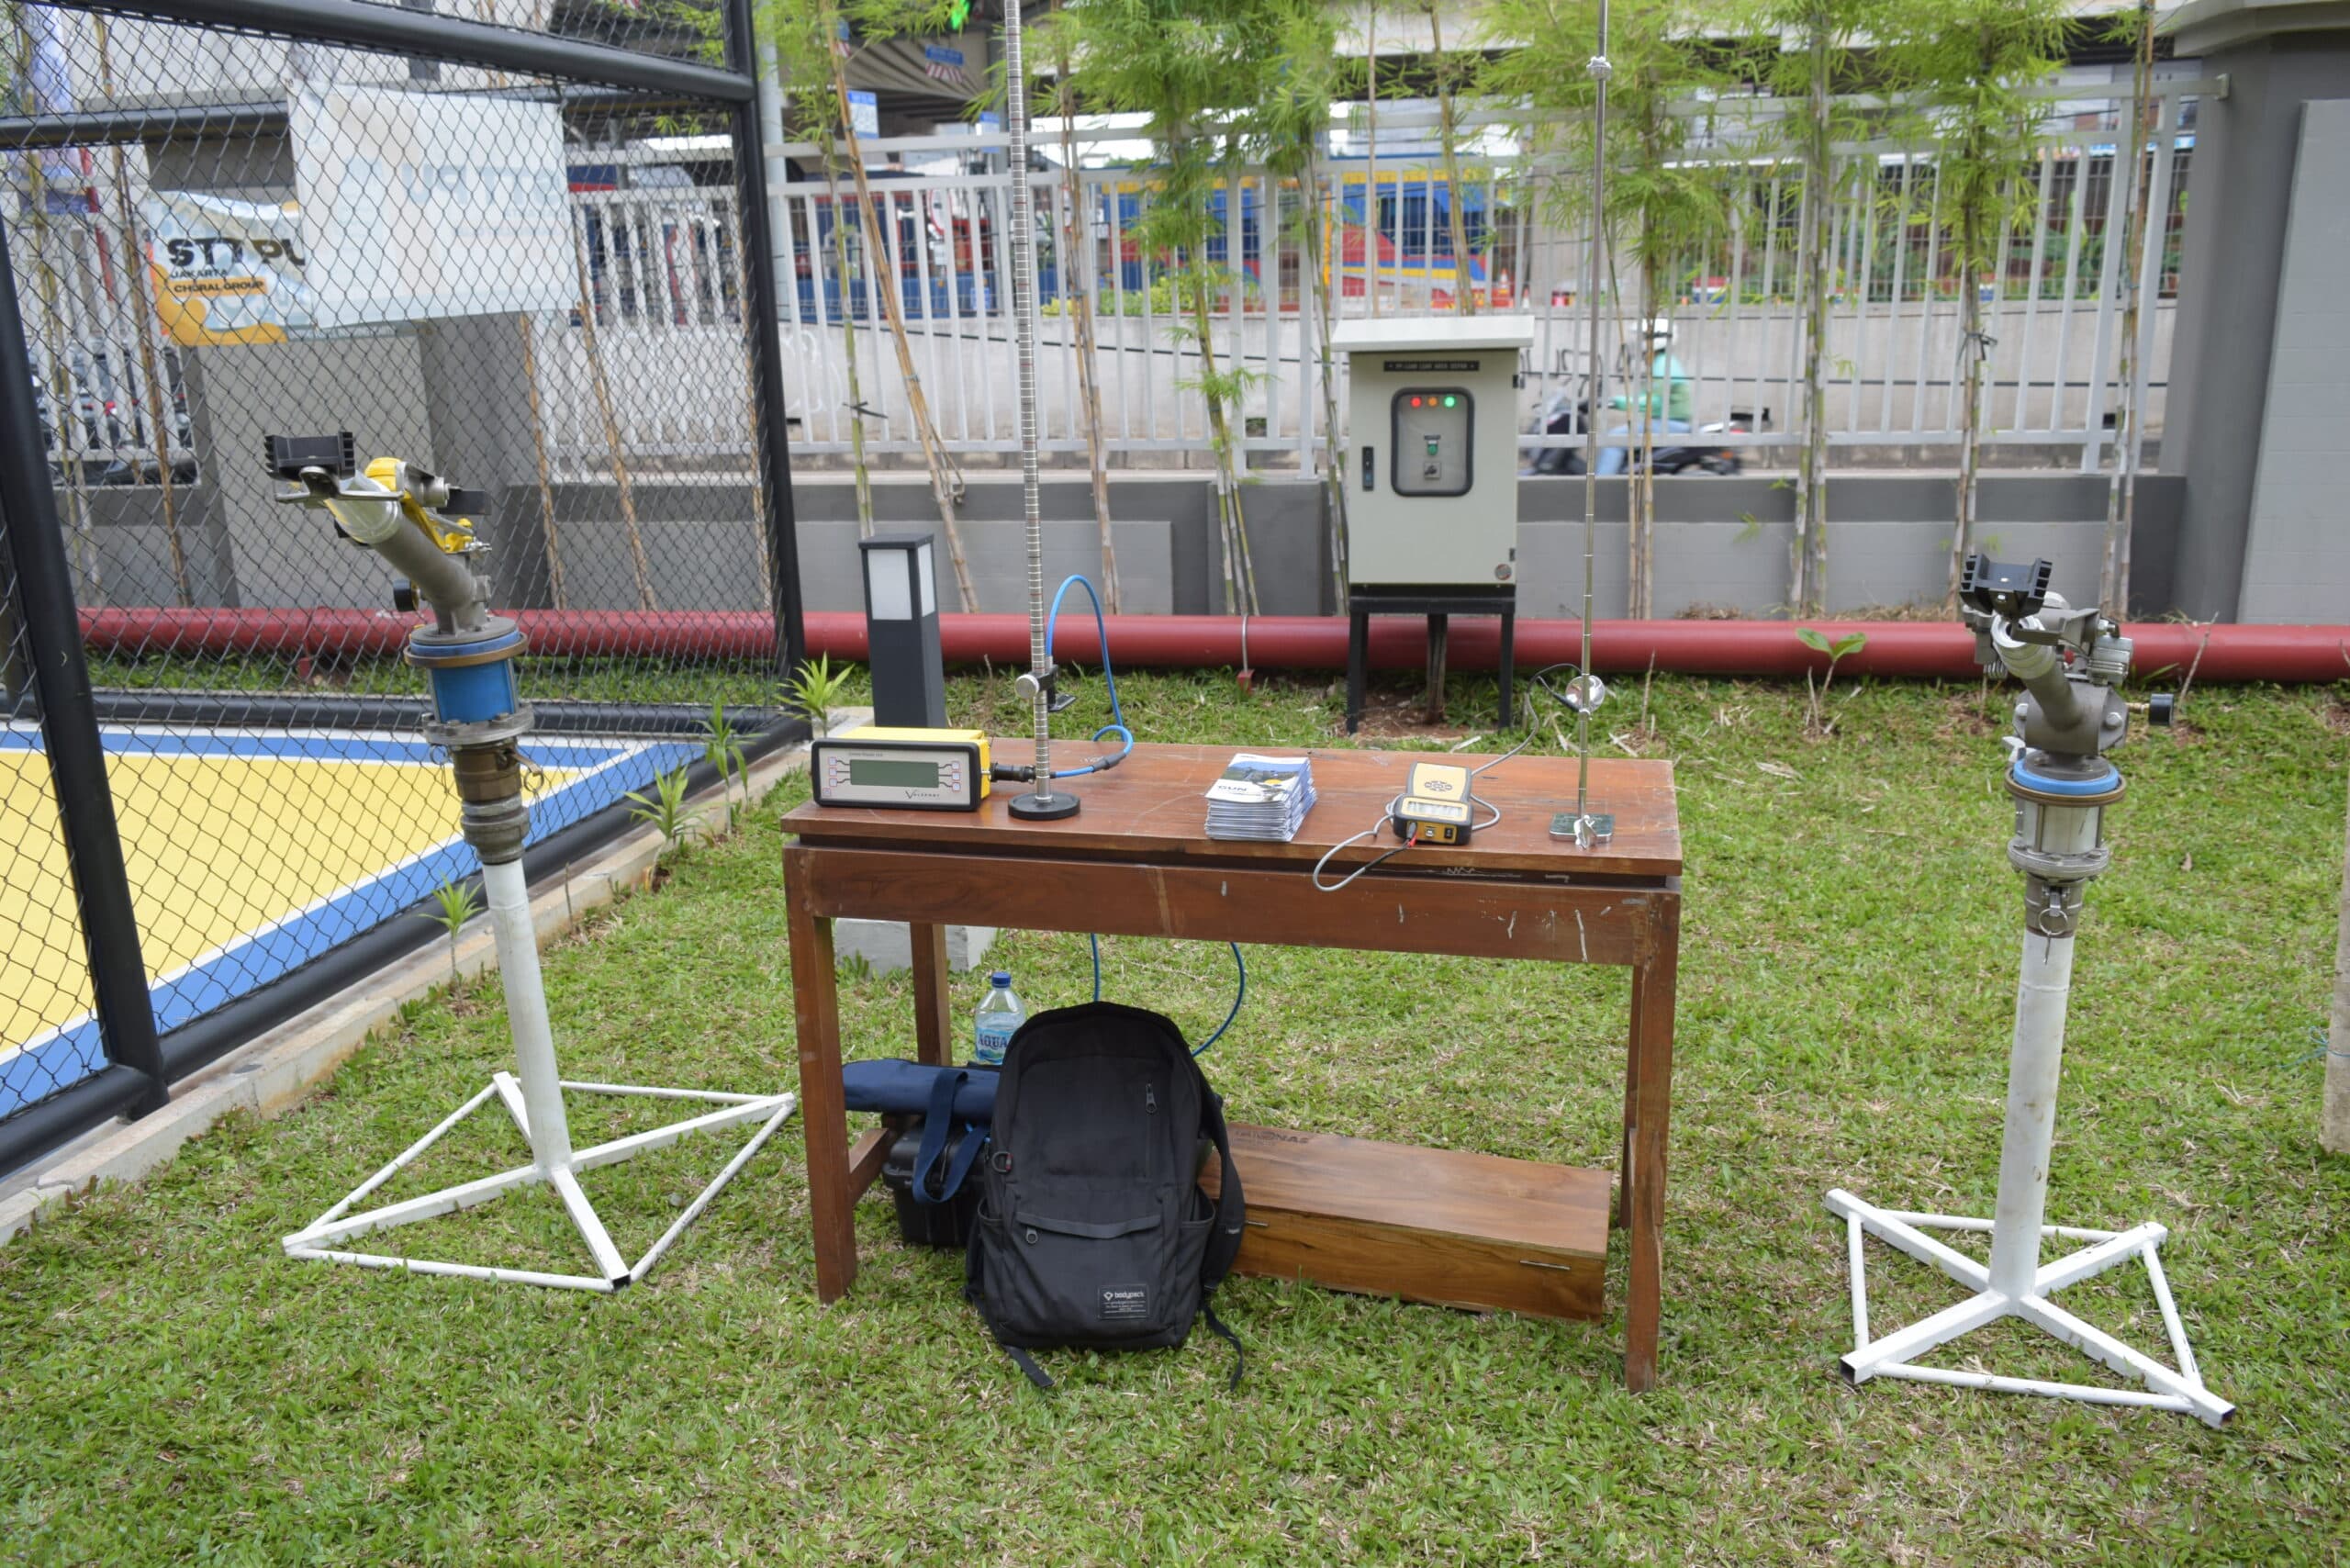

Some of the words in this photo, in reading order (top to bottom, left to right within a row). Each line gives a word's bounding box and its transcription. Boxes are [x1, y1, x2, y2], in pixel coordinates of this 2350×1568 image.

[168, 238, 243, 267] STT
[170, 269, 228, 278] JAKARTA
[173, 281, 221, 293] CHORAL
[224, 280, 263, 291] GROUP
[979, 1034, 1008, 1050] AQUA
